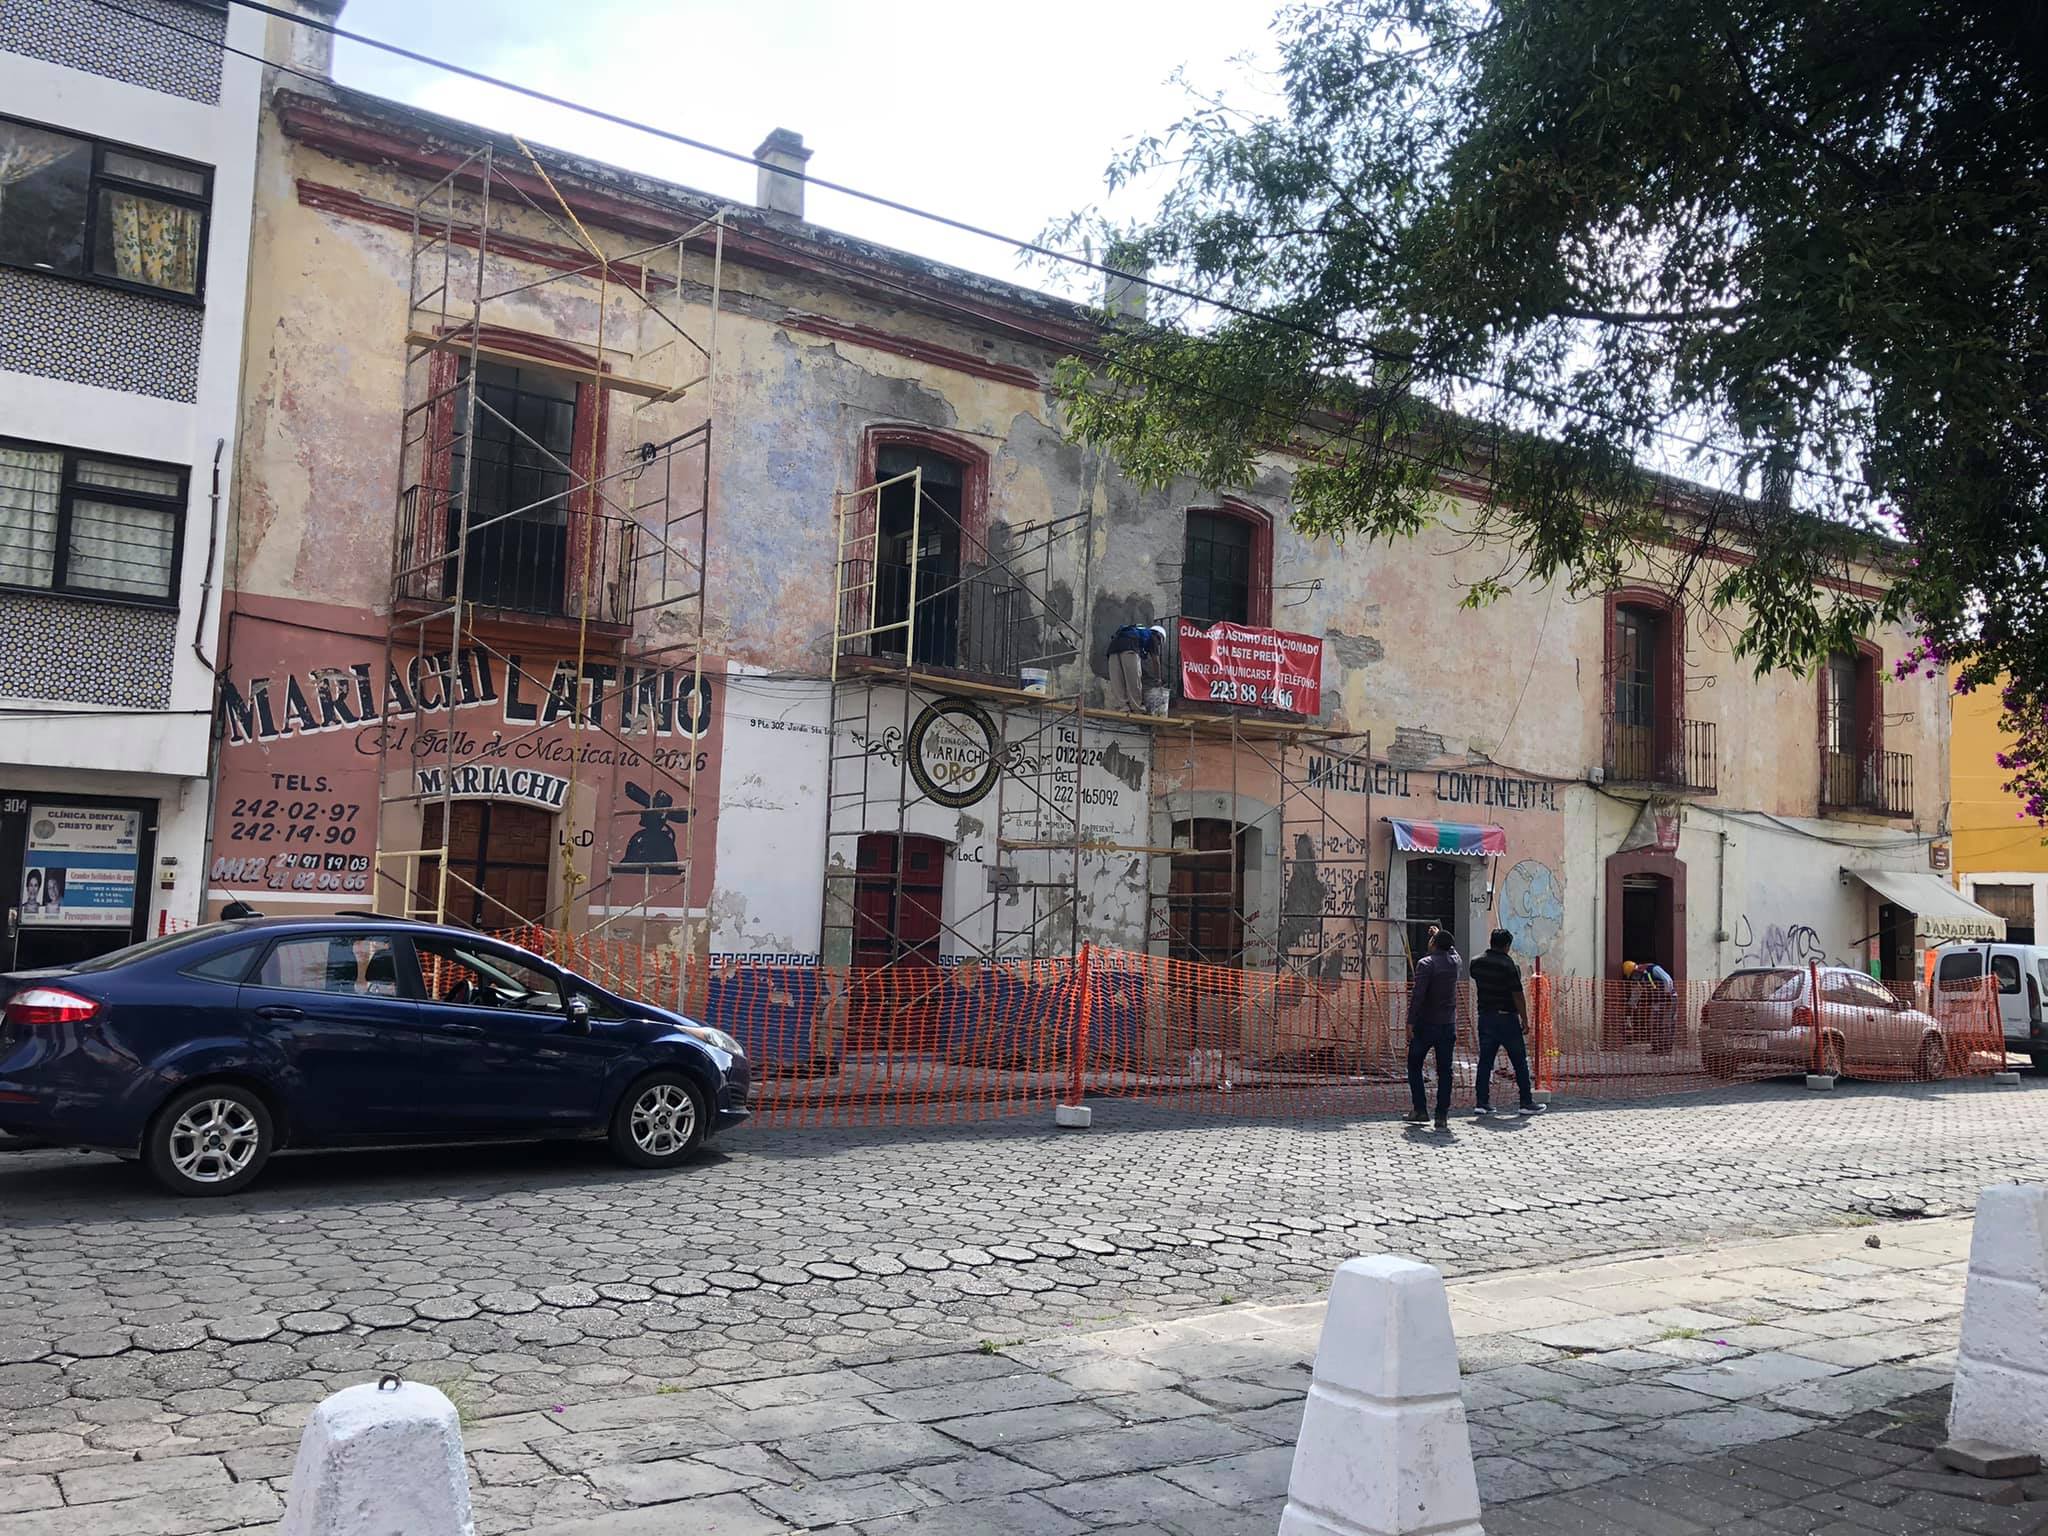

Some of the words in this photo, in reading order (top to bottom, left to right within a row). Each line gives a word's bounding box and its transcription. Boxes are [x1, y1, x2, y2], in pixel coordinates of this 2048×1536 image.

[1226, 630, 1260, 644] ASUNTO
[1261, 635, 1319, 655] RELACIONADO
[1231, 648, 1251, 660] ESTE
[1183, 661, 1211, 675] FAVOR
[219, 646, 499, 747] MARIACHI
[503, 654, 713, 740] LATINO
[1210, 680, 1238, 700] 223
[1240, 684, 1257, 703] 88
[750, 718, 756, 727] 9
[771, 721, 785, 731] 302
[1057, 727, 1077, 744] TEL
[355, 725, 408, 755] El
[411, 728, 476, 759] Gallo
[482, 733, 508, 758] de
[514, 737, 641, 767] Mexicana
[932, 761, 977, 786] ORO
[271, 773, 333, 793] TELS.
[417, 764, 569, 807] MARIACHI
[1436, 771, 1560, 812] CONTINENTAL
[3, 798, 28, 814] 304
[88, 812, 126, 822] DENTAL
[1024, 820, 1042, 828] MEJR
[57, 821, 93, 831] CRISTO
[95, 823, 115, 832] REY
[301, 855, 318, 870] 91
[326, 856, 343, 871] 19
[350, 856, 369, 871] 03
